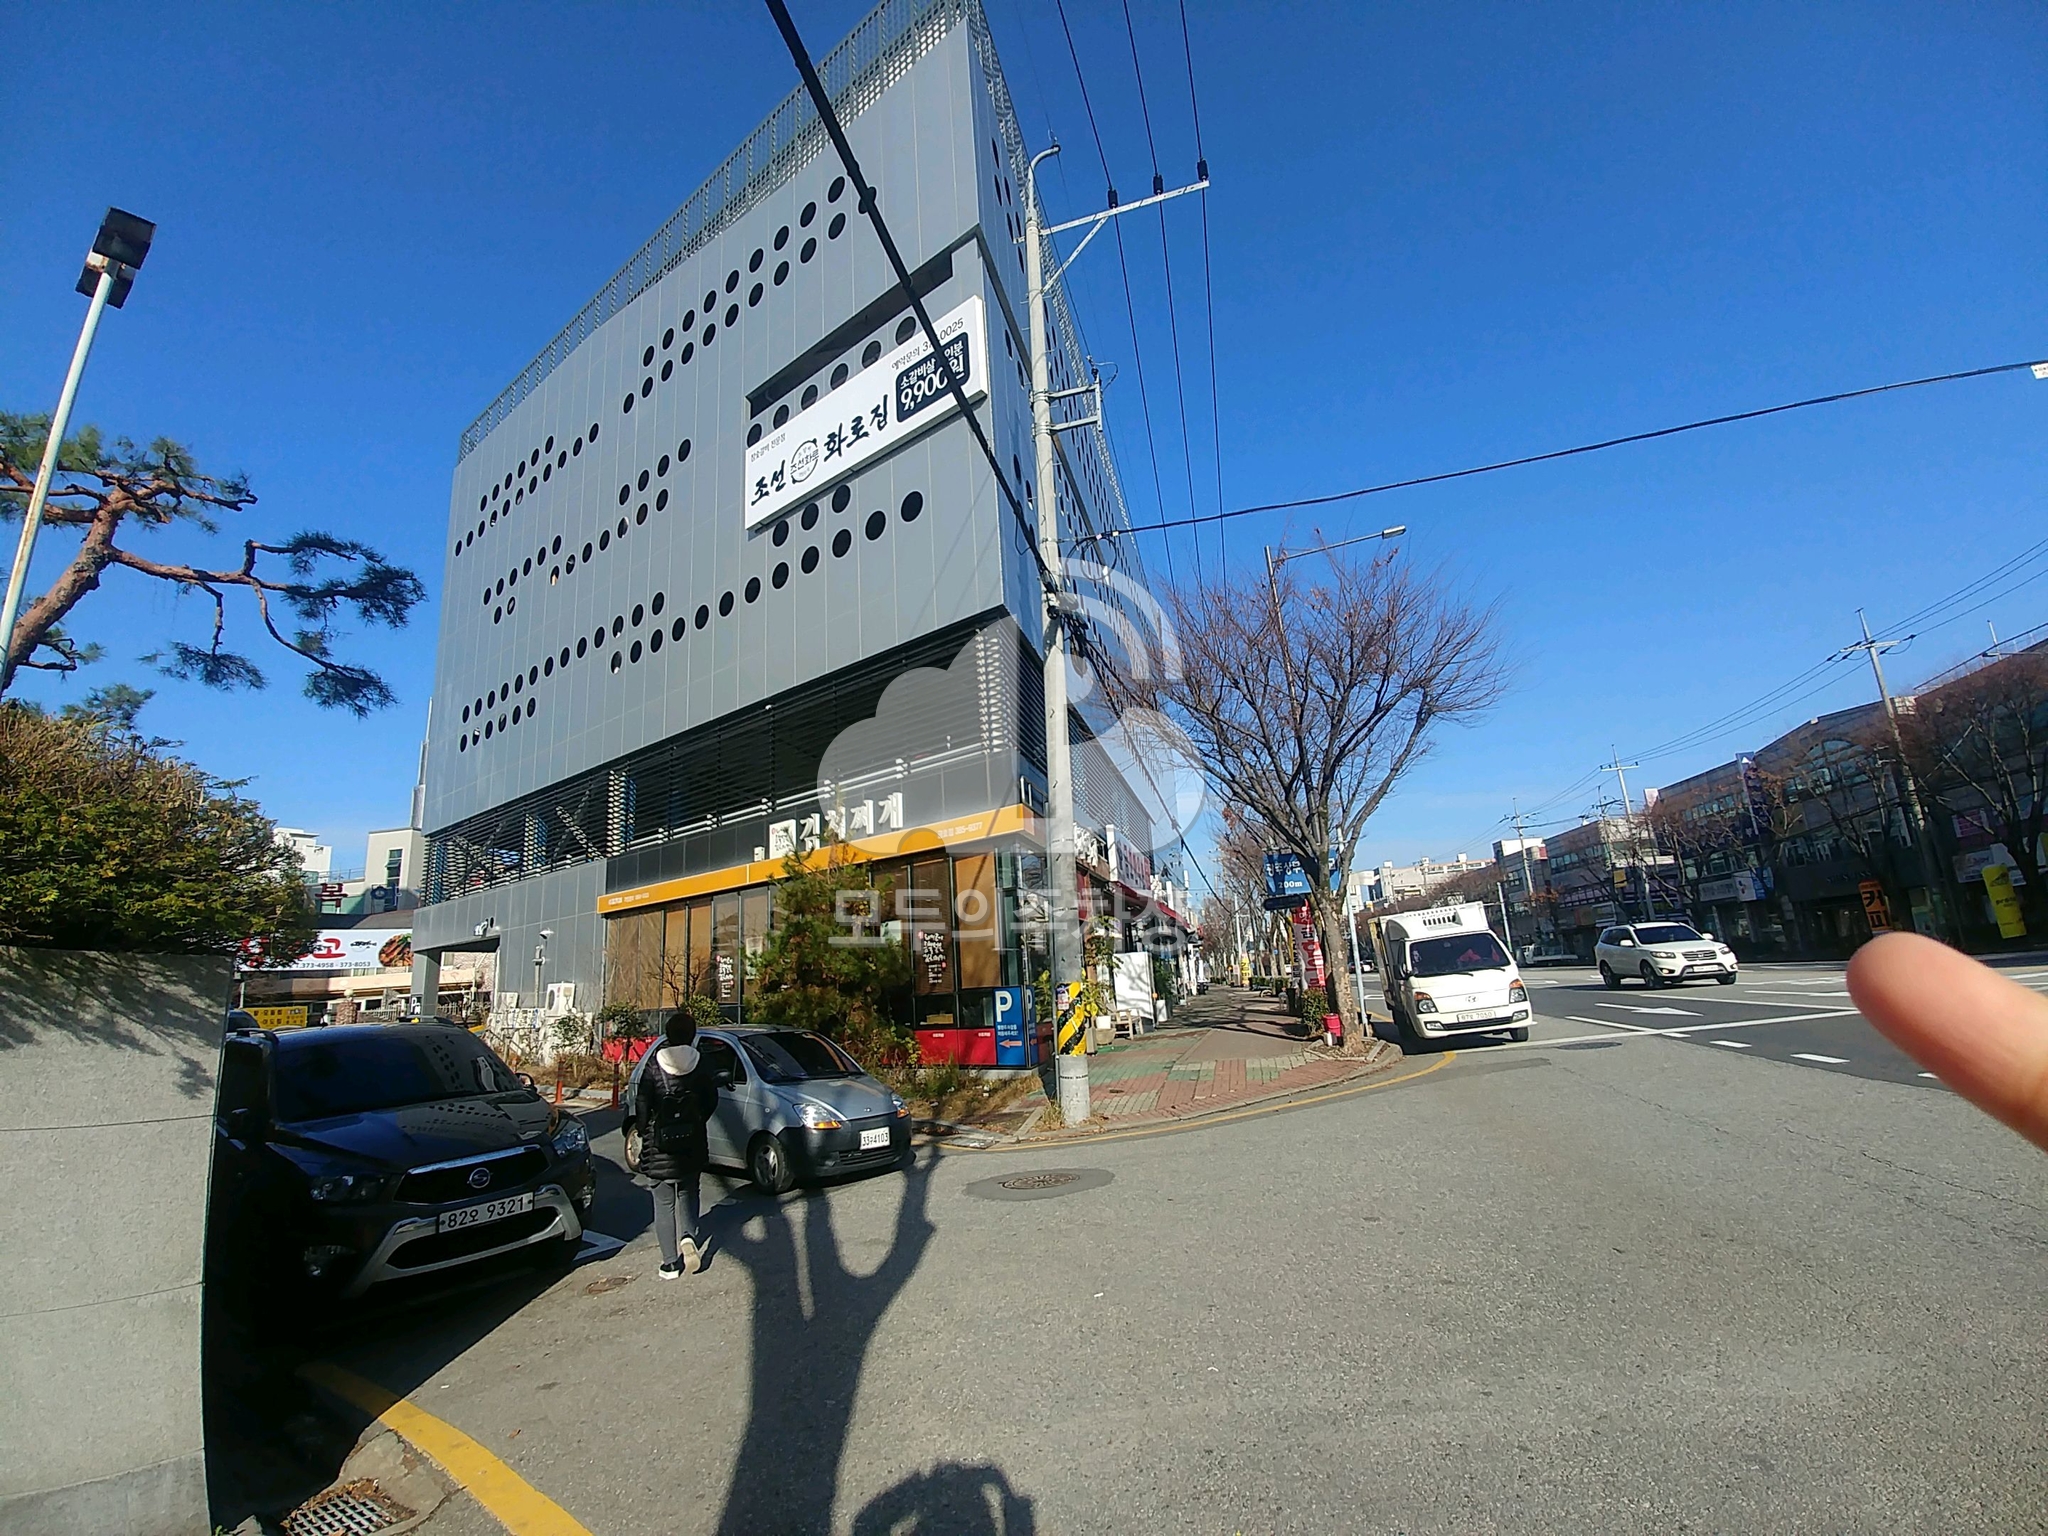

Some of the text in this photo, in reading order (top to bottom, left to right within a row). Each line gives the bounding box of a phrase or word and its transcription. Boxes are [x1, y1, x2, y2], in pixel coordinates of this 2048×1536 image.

[900, 357, 936, 390] 소갈비살
[751, 394, 889, 506] 조선 화로집
[800, 791, 904, 851] 김치찌개
[1277, 880, 1303, 889] 200m
[1862, 889, 1892, 928] 커피
[995, 990, 1013, 1023] P
[447, 1196, 525, 1228] 82오 9321
